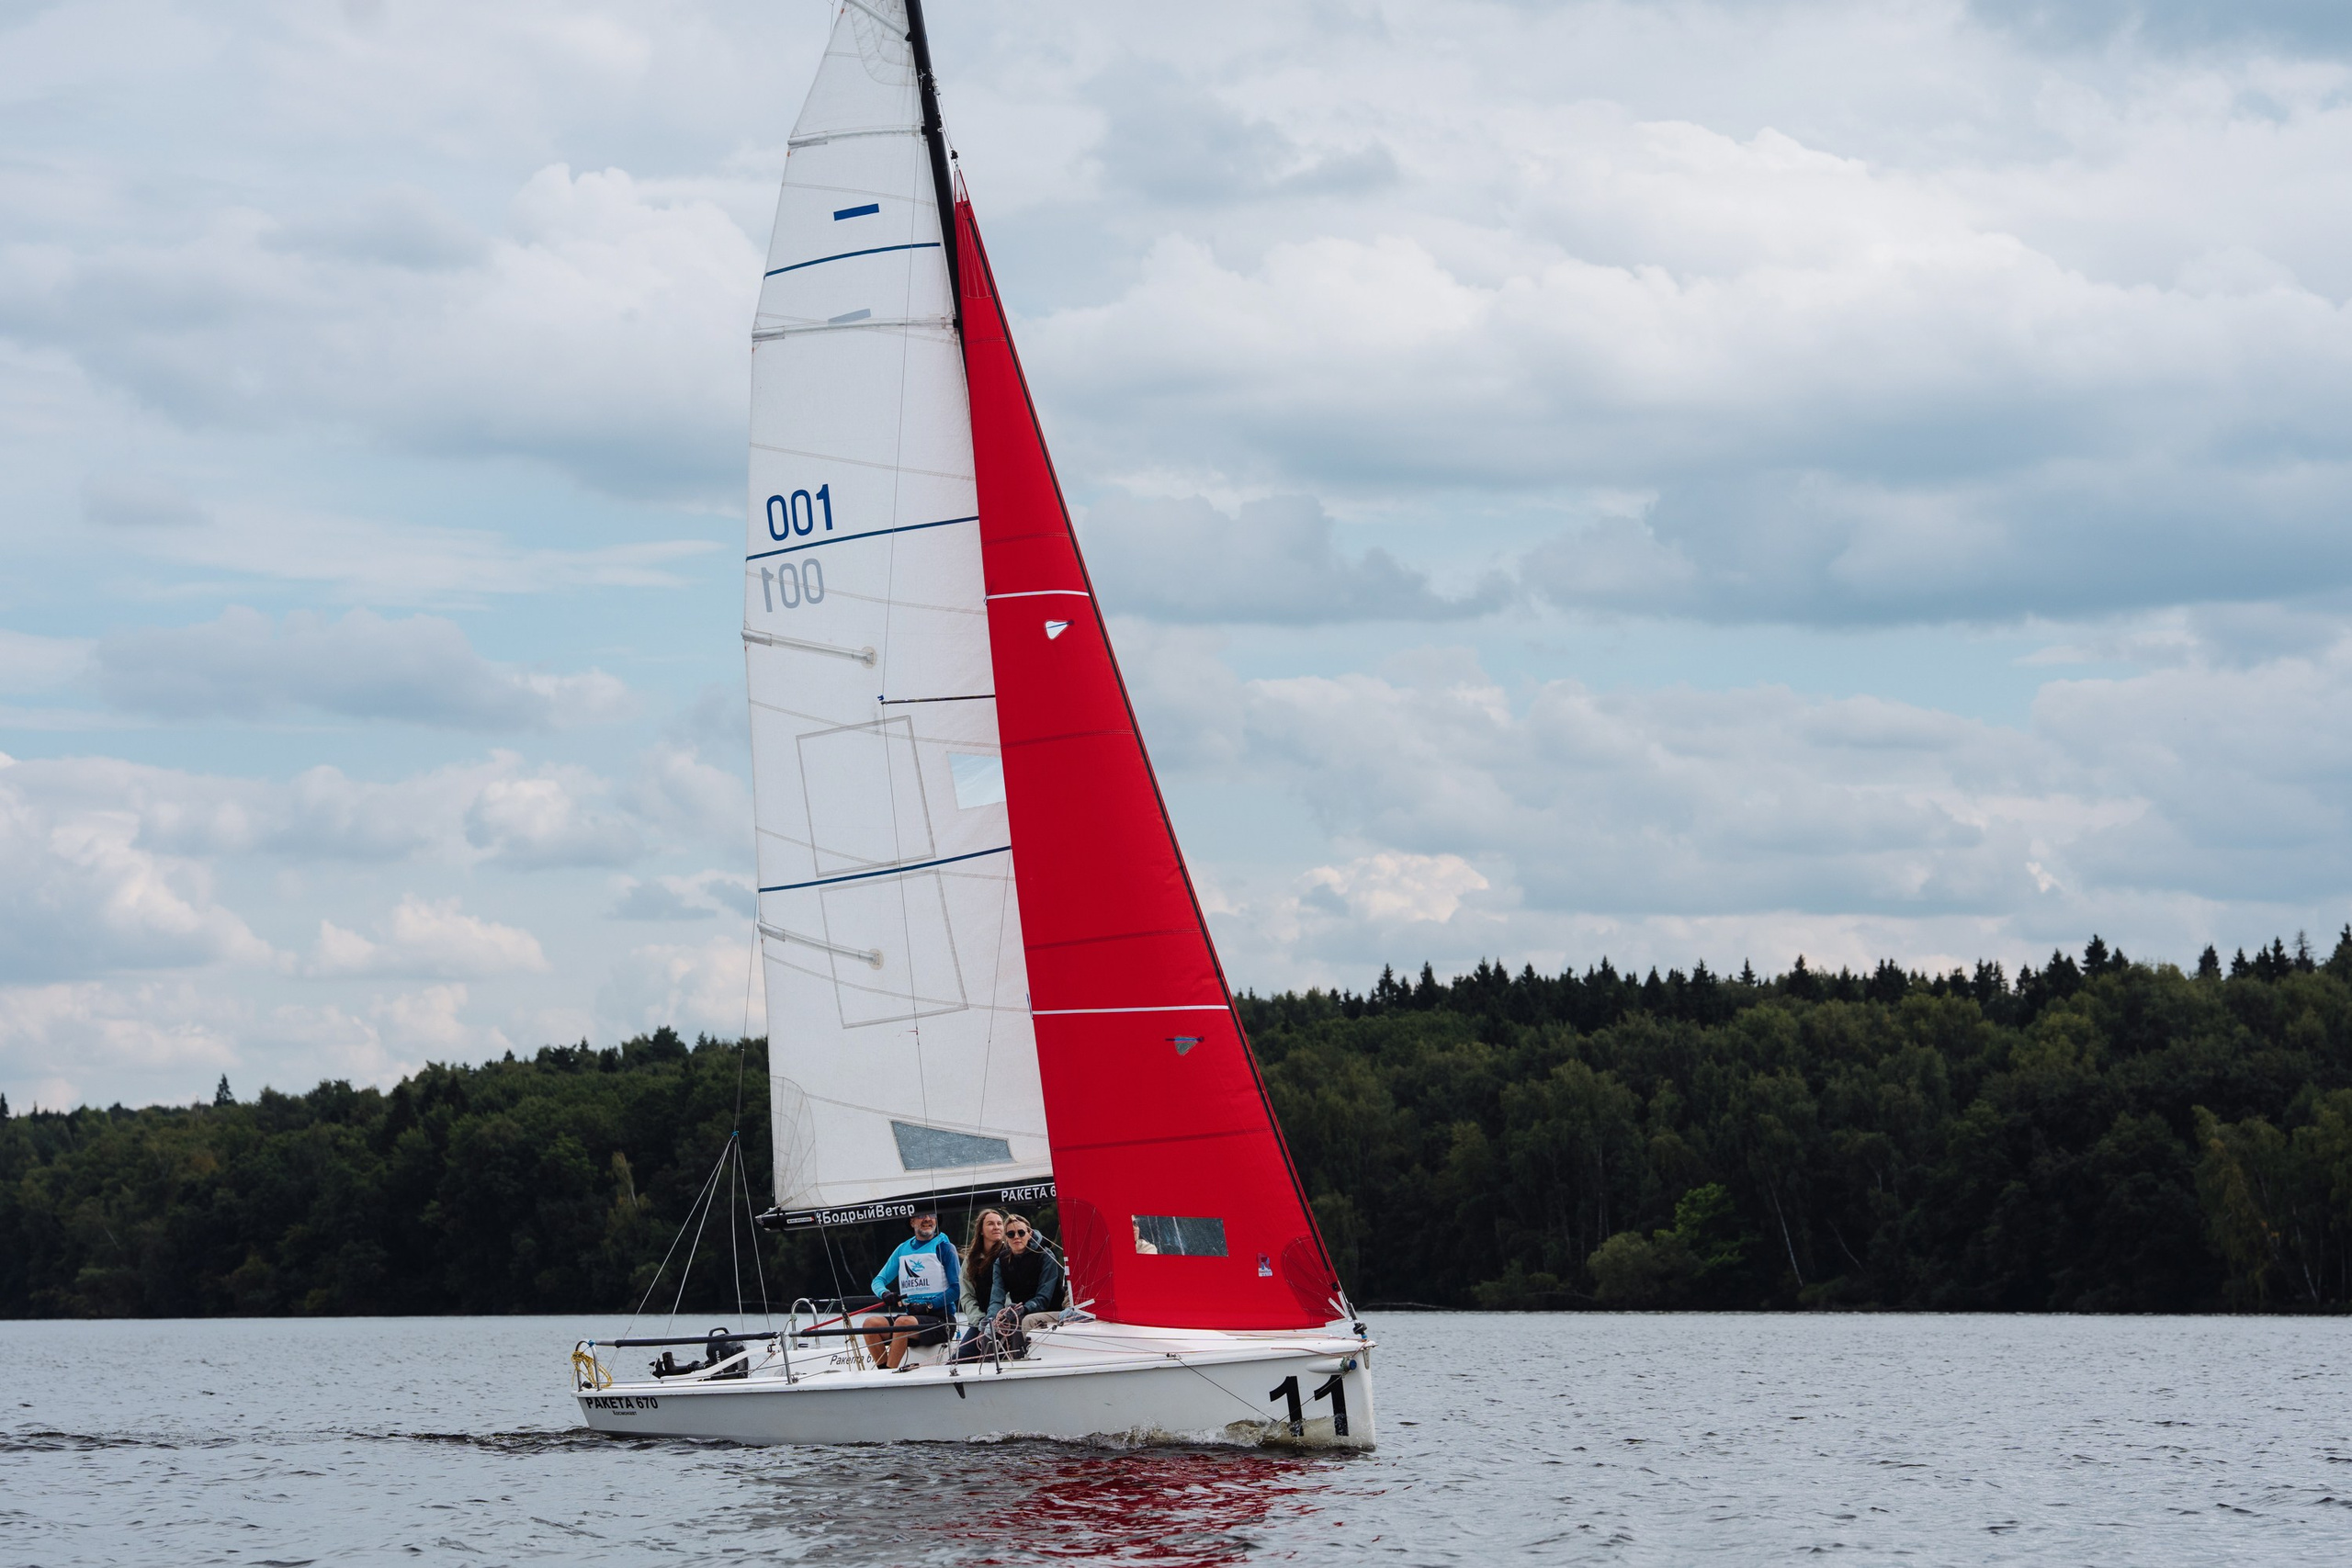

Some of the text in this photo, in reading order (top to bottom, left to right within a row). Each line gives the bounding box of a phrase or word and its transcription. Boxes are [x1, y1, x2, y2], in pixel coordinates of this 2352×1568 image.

[766, 483, 833, 541] 001
[1001, 1185, 1057, 1202] РАКЕТА 6
[816, 1203, 915, 1225] #БодрыйВетер
[585, 1397, 659, 1409] РАКЕТА 670
[1269, 1374, 1349, 1437] 11
